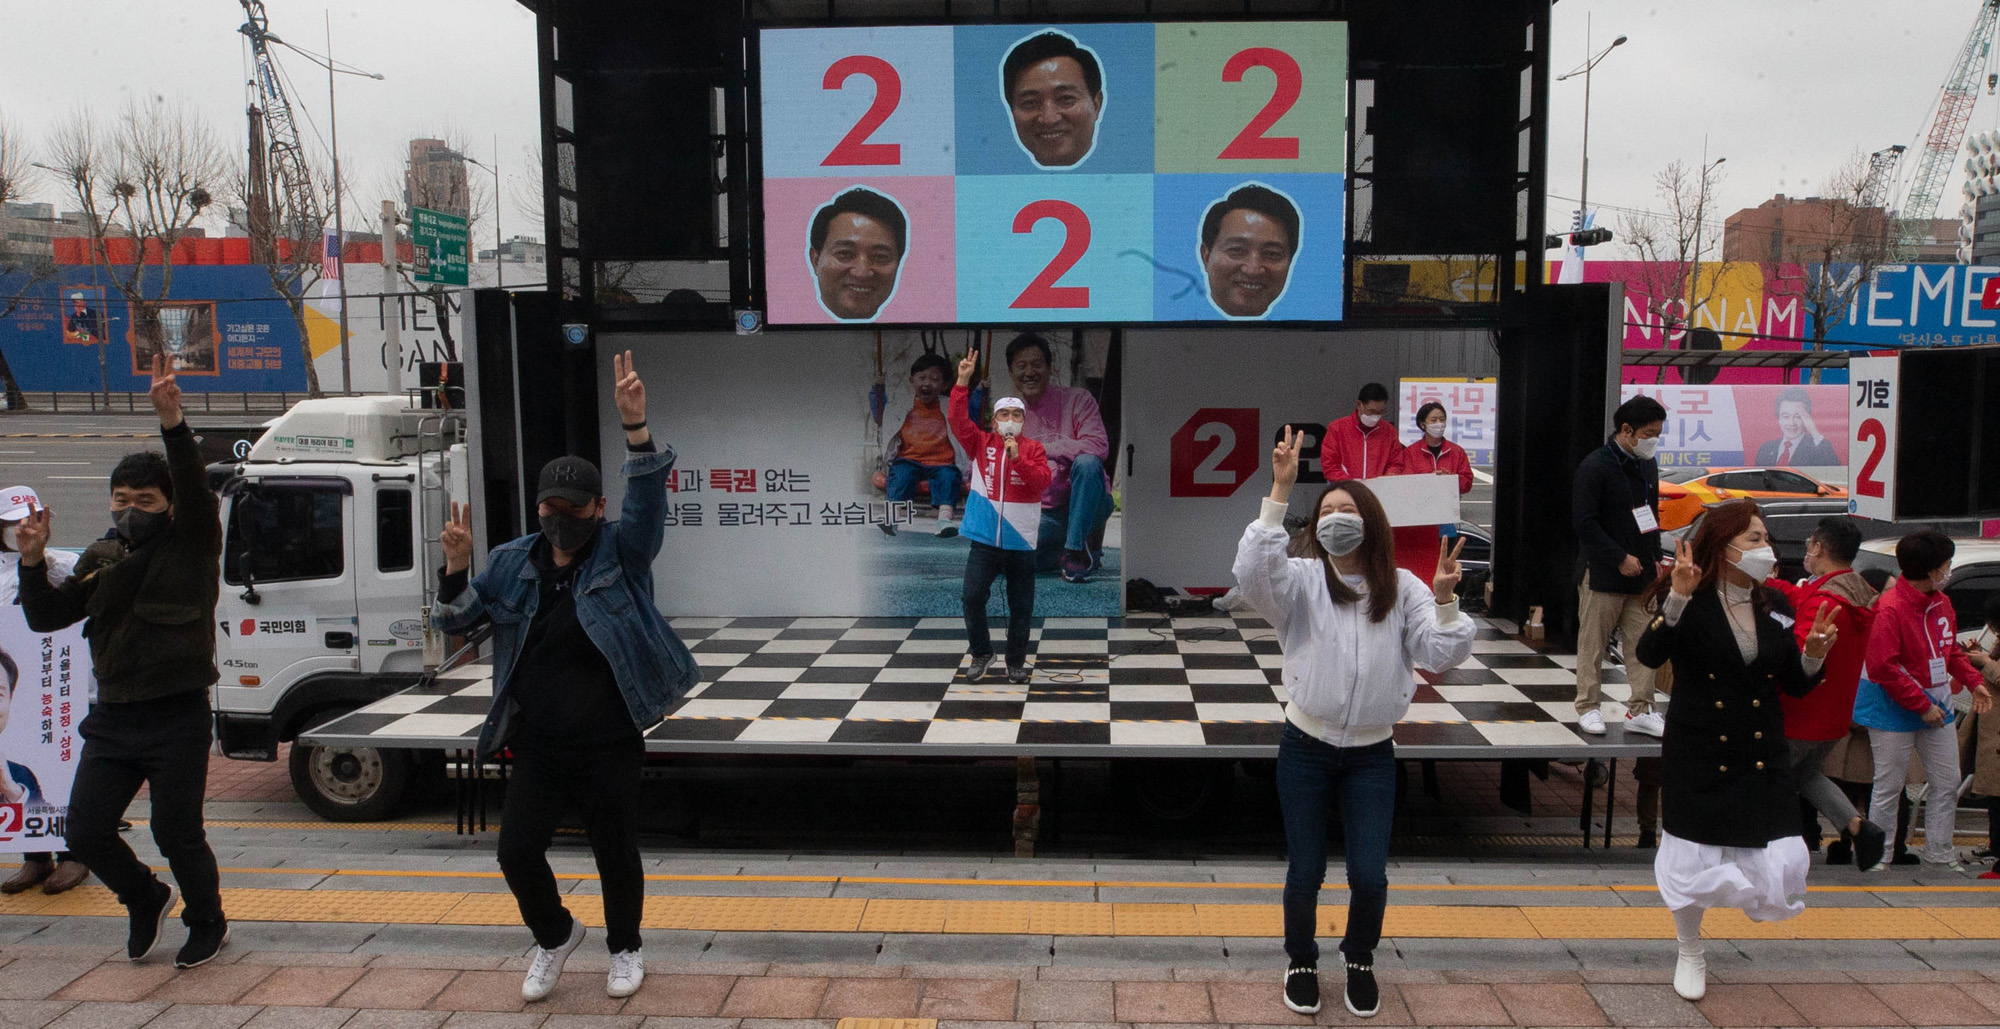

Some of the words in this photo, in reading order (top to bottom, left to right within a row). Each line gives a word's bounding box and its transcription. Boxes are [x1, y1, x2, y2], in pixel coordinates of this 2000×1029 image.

[820, 55, 901, 167] 2
[1216, 47, 1302, 159] 2
[1008, 199, 1092, 309] 2
[1856, 379, 1889, 408] 기호
[1193, 422, 1236, 484] 2
[1856, 418, 1886, 498] 2
[710, 469, 757, 493] 특권
[765, 469, 810, 492] 없는
[717, 503, 812, 526] 물려주고
[820, 501, 916, 526] 싶습니다
[260, 620, 306, 633] 국민의힘
[1938, 617, 1953, 638] 2
[41, 636, 53, 688] 첫날부터
[60, 645, 71, 697] 서울부터
[41, 693, 53, 744] 능숙하게
[25, 817, 65, 837] 오세
